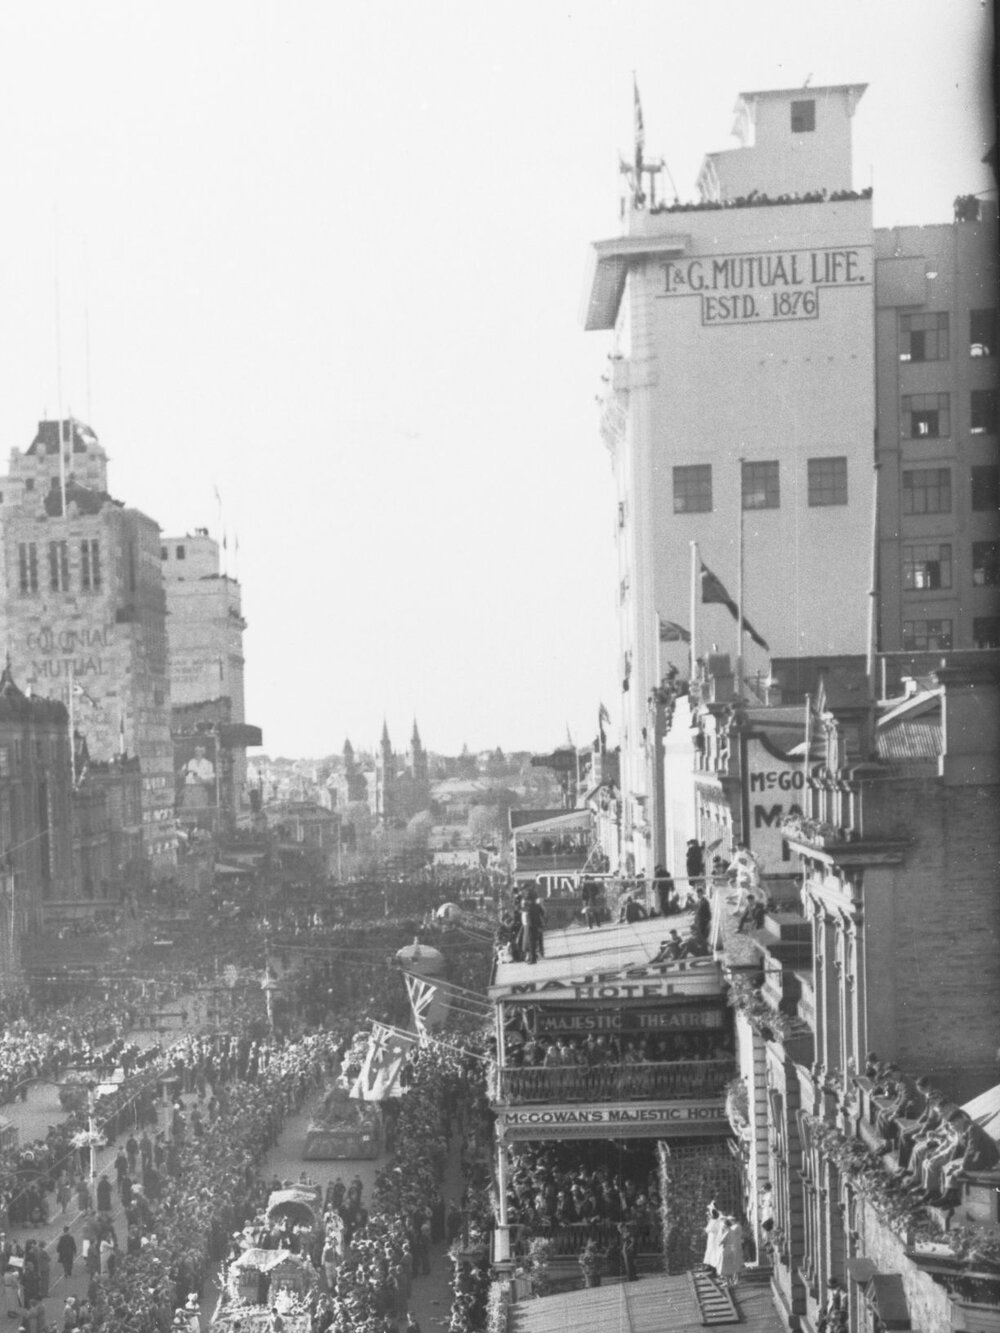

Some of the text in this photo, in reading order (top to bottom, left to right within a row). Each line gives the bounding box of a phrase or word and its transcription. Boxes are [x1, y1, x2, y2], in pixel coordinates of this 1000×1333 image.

[712, 254, 803, 290] MUTUAL
[811, 251, 865, 284] LIFE.
[705, 291, 816, 320] ESTD. 1876
[26, 627, 113, 650] COLONIAL
[31, 657, 108, 678] MUTUAL
[750, 770, 804, 793] McGO
[511, 958, 714, 995] MAJESTIC
[574, 984, 685, 999] HOTEL
[546, 1014, 622, 1030] MAJESTIC
[505, 1106, 726, 1124] McGOWAN'S MAJESTIC HOTE
